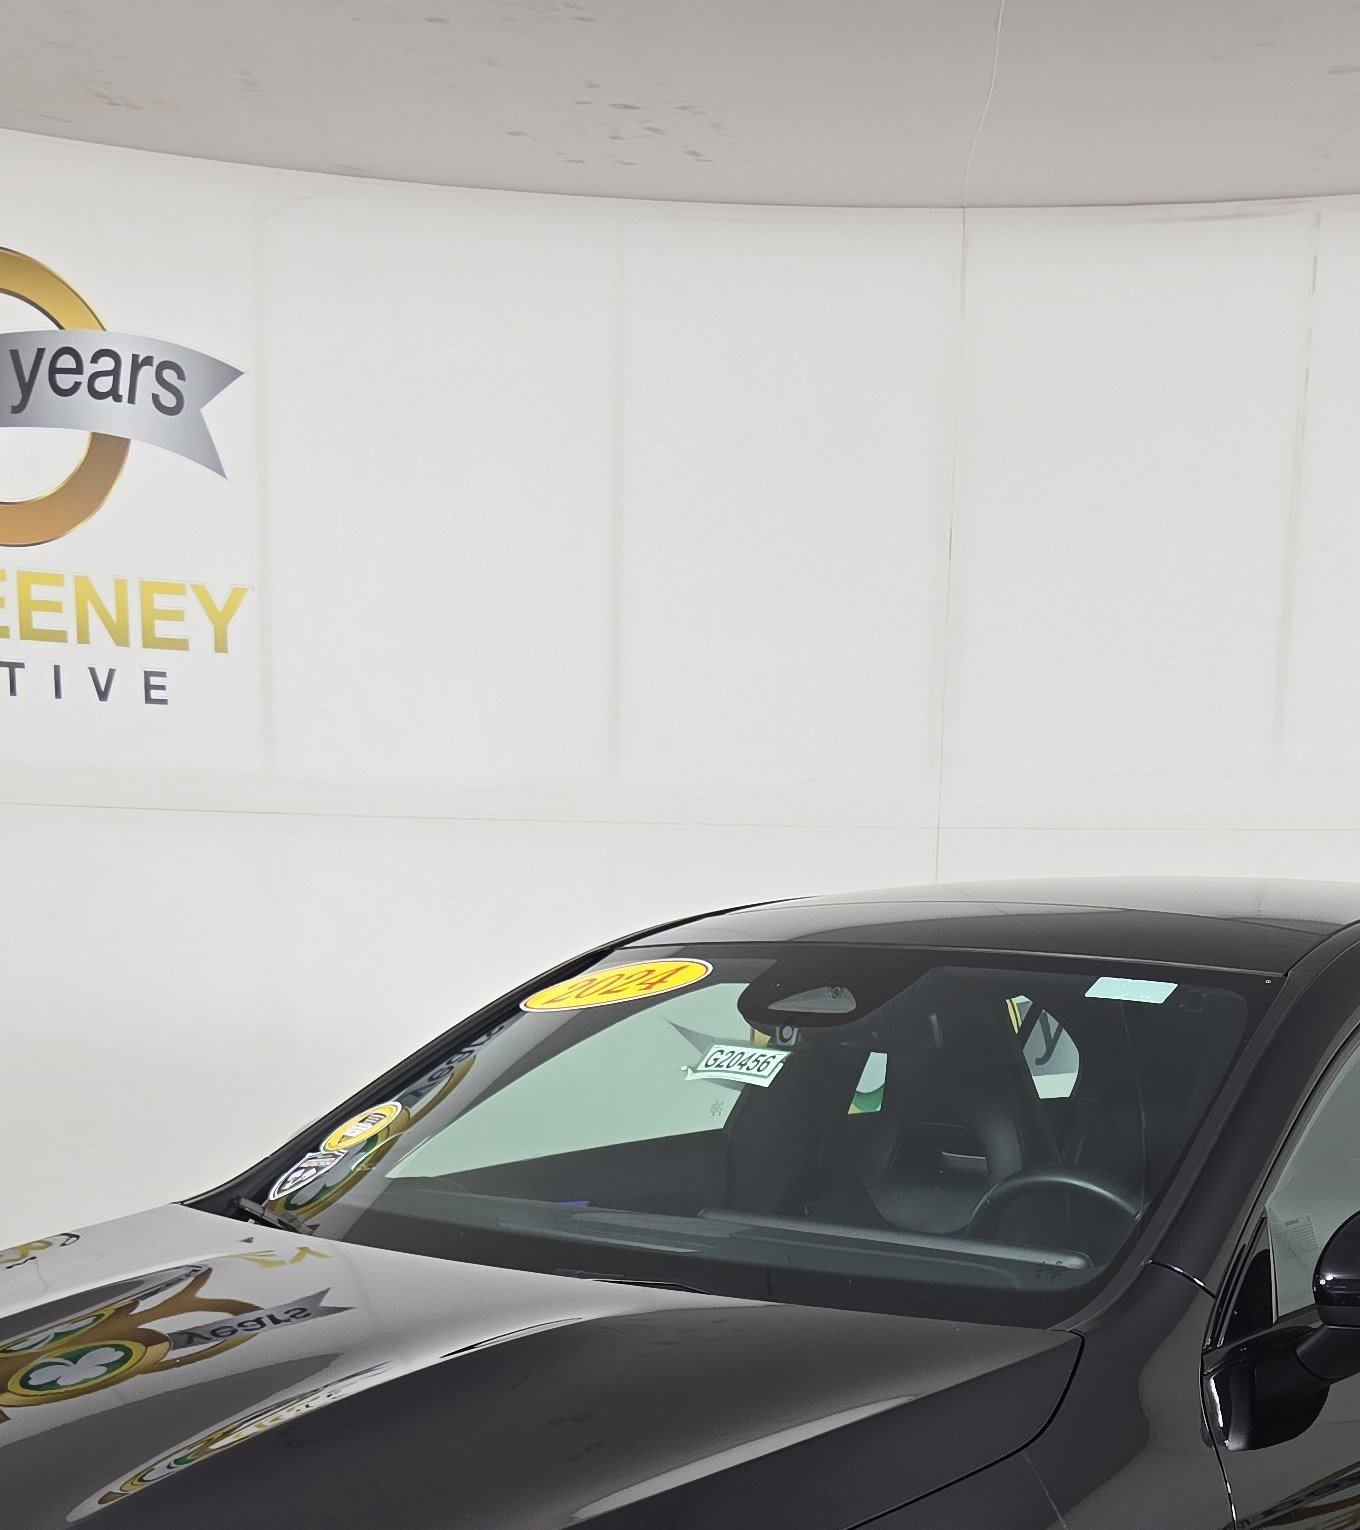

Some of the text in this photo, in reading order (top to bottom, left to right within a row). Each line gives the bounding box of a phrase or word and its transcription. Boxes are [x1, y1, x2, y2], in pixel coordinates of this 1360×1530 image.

[9, 341, 186, 416] years
[542, 965, 691, 1005] 2024
[705, 1049, 776, 1073] G20456
